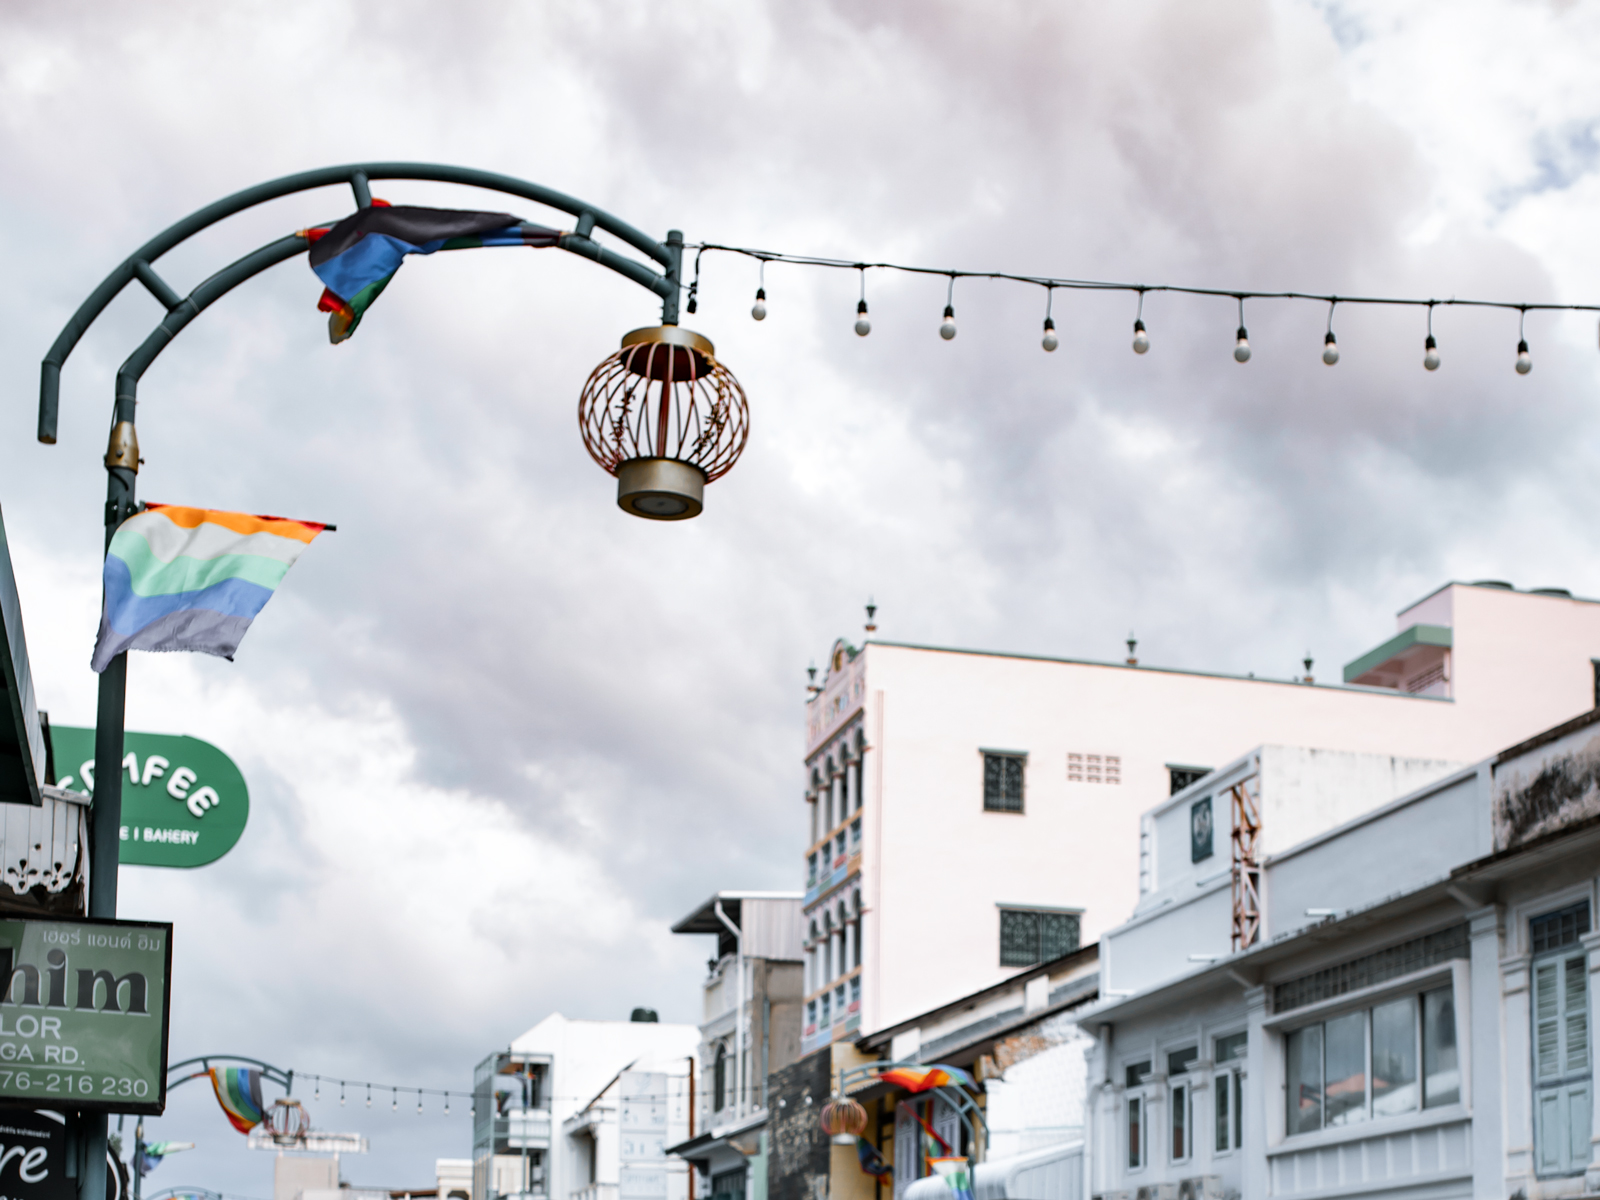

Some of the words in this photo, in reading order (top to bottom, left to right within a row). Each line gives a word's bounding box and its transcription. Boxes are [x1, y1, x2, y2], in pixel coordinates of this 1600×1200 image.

[143, 827, 199, 845] BAKERY
[88, 932, 132, 950] แอนด์
[45, 1045, 85, 1066] RD.
[102, 1076, 149, 1097] 230
